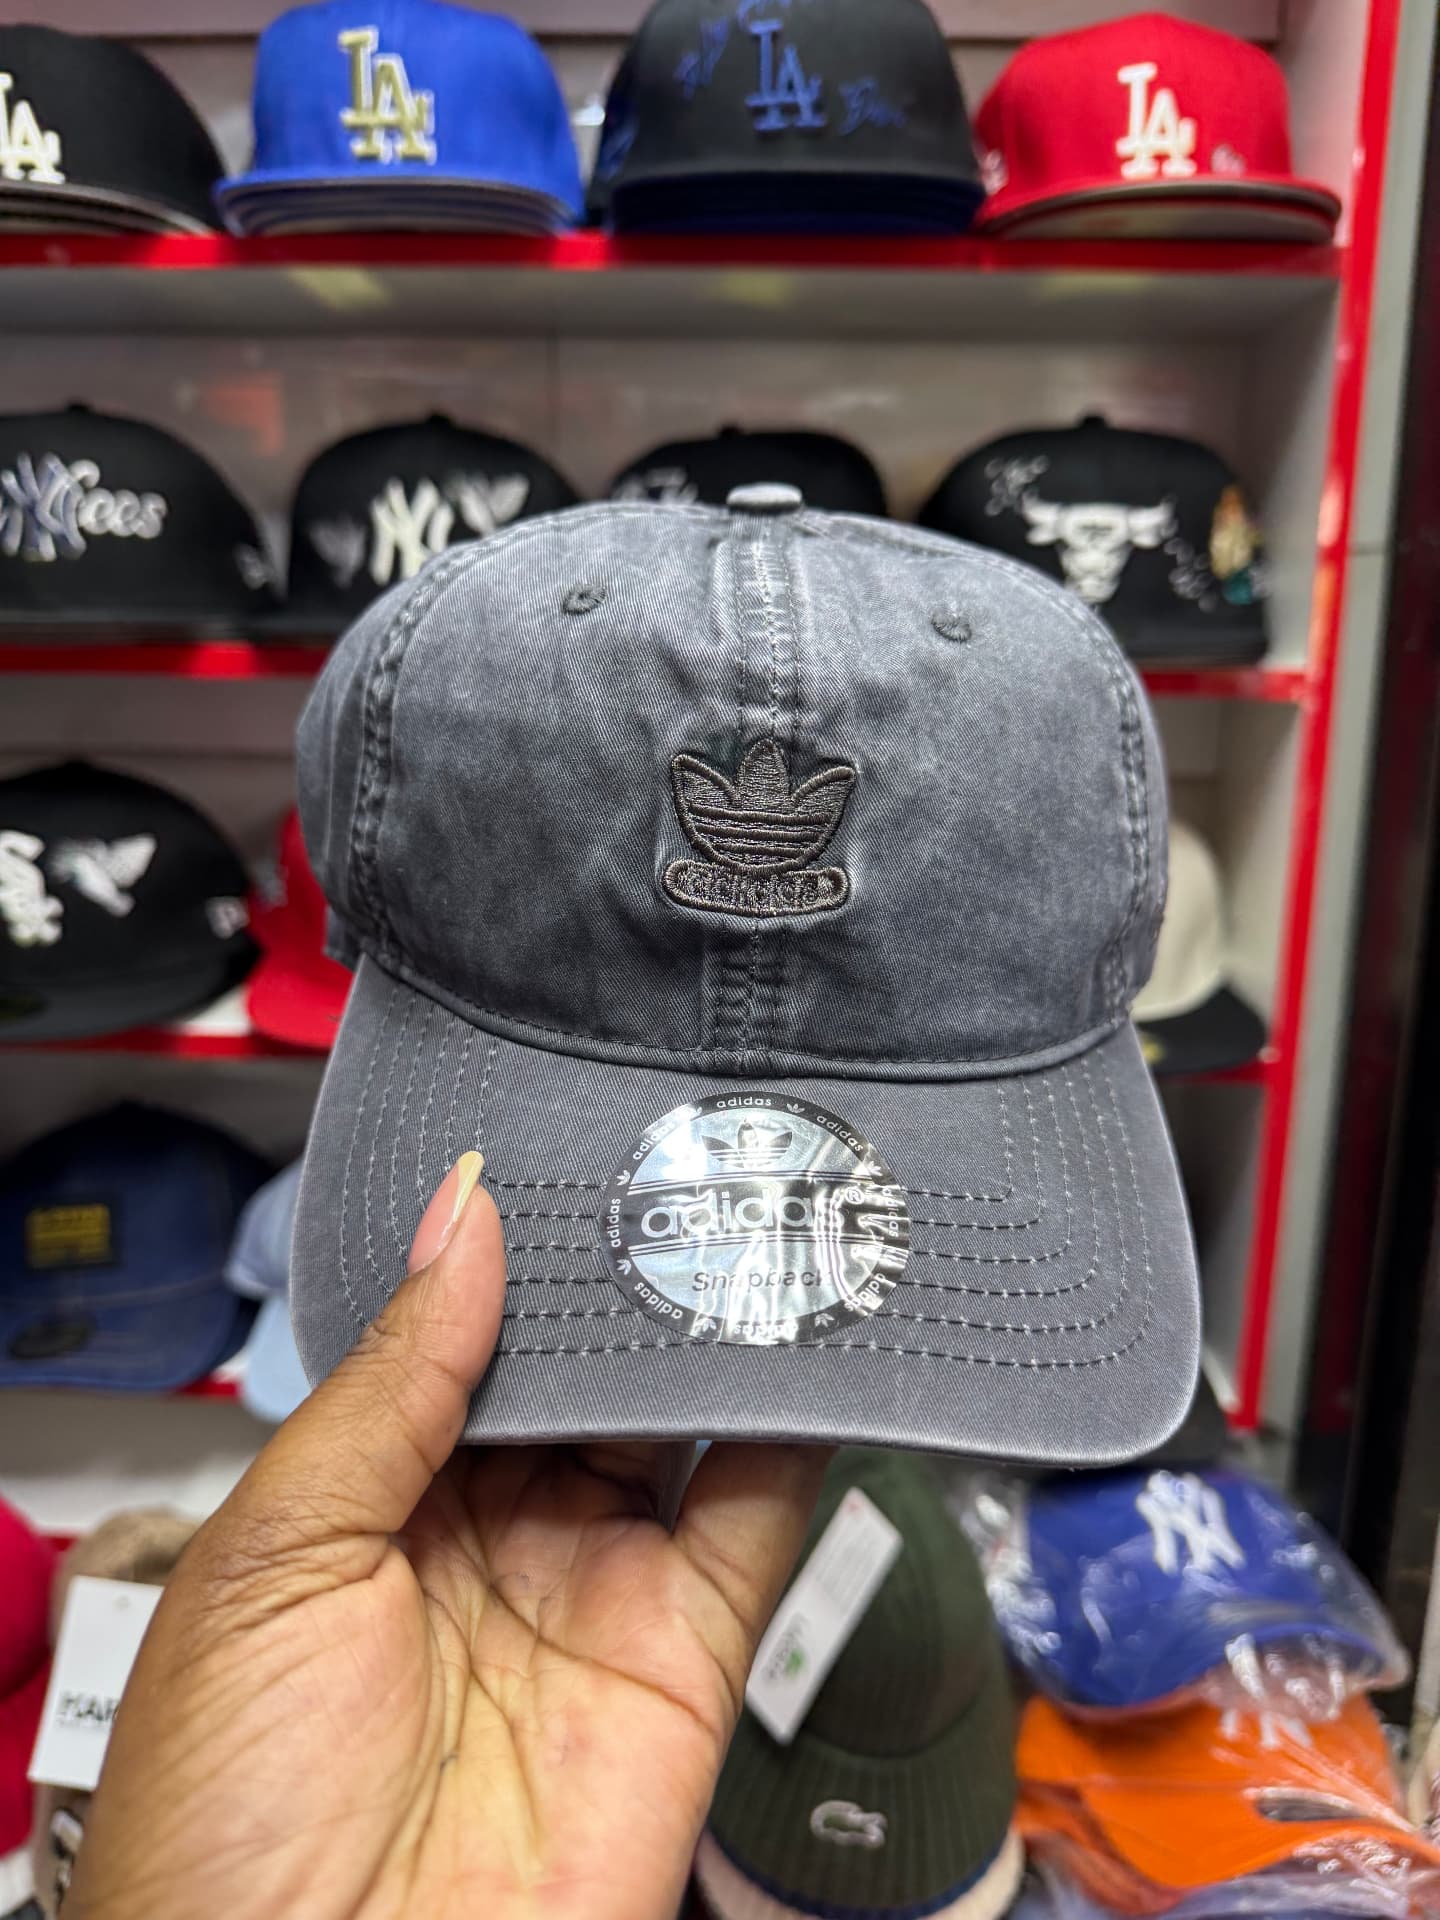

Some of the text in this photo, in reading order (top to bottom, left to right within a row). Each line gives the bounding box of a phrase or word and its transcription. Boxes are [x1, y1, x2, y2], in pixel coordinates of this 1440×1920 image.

[338, 25, 437, 165] LA
[745, 18, 828, 132] LA
[1115, 62, 1199, 180] LA
[716, 1096, 772, 1109] adidas
[632, 1120, 677, 1161] adidas
[816, 1113, 864, 1153] adidas
[606, 1197, 622, 1249] adidas
[633, 1281, 683, 1321] adidas
